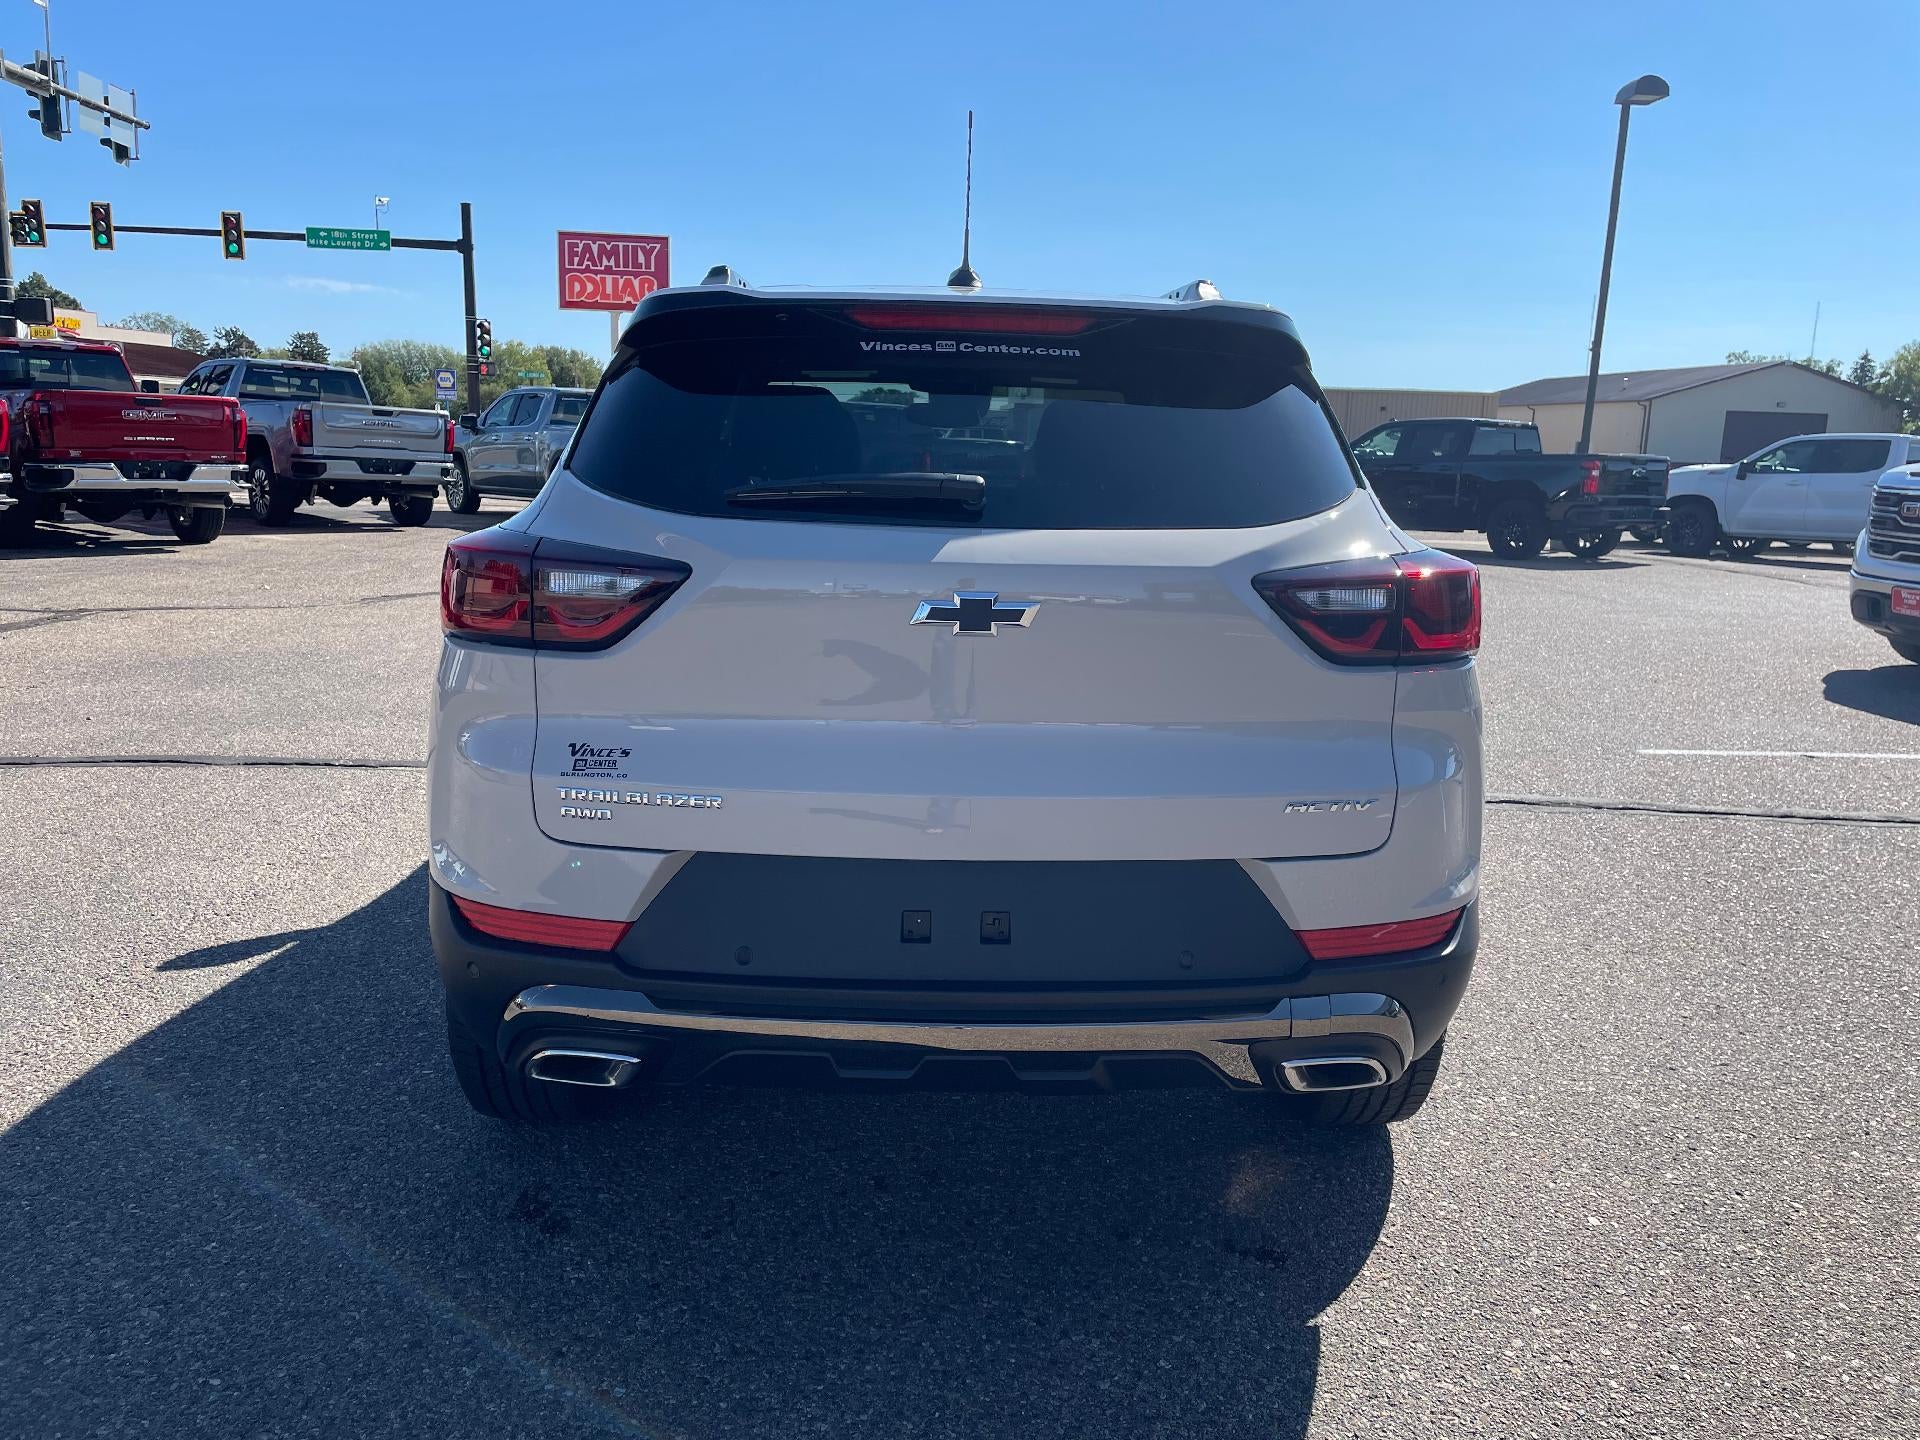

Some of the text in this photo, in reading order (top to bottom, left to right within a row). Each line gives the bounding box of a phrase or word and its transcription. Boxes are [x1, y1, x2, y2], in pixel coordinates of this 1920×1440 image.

[331, 231, 347, 239] 18th
[331, 240, 360, 248] Lounge
[564, 240, 661, 271] FAMILY
[565, 273, 658, 304] DOLLAR
[860, 341, 932, 351] Vinces
[959, 342, 1081, 356] Center.com
[122, 410, 177, 420] GMC
[588, 760, 618, 768] CENTER
[556, 786, 724, 809] TRAILBLAZER
[560, 806, 613, 821] AWD
[1283, 799, 1379, 814] ACTIV
